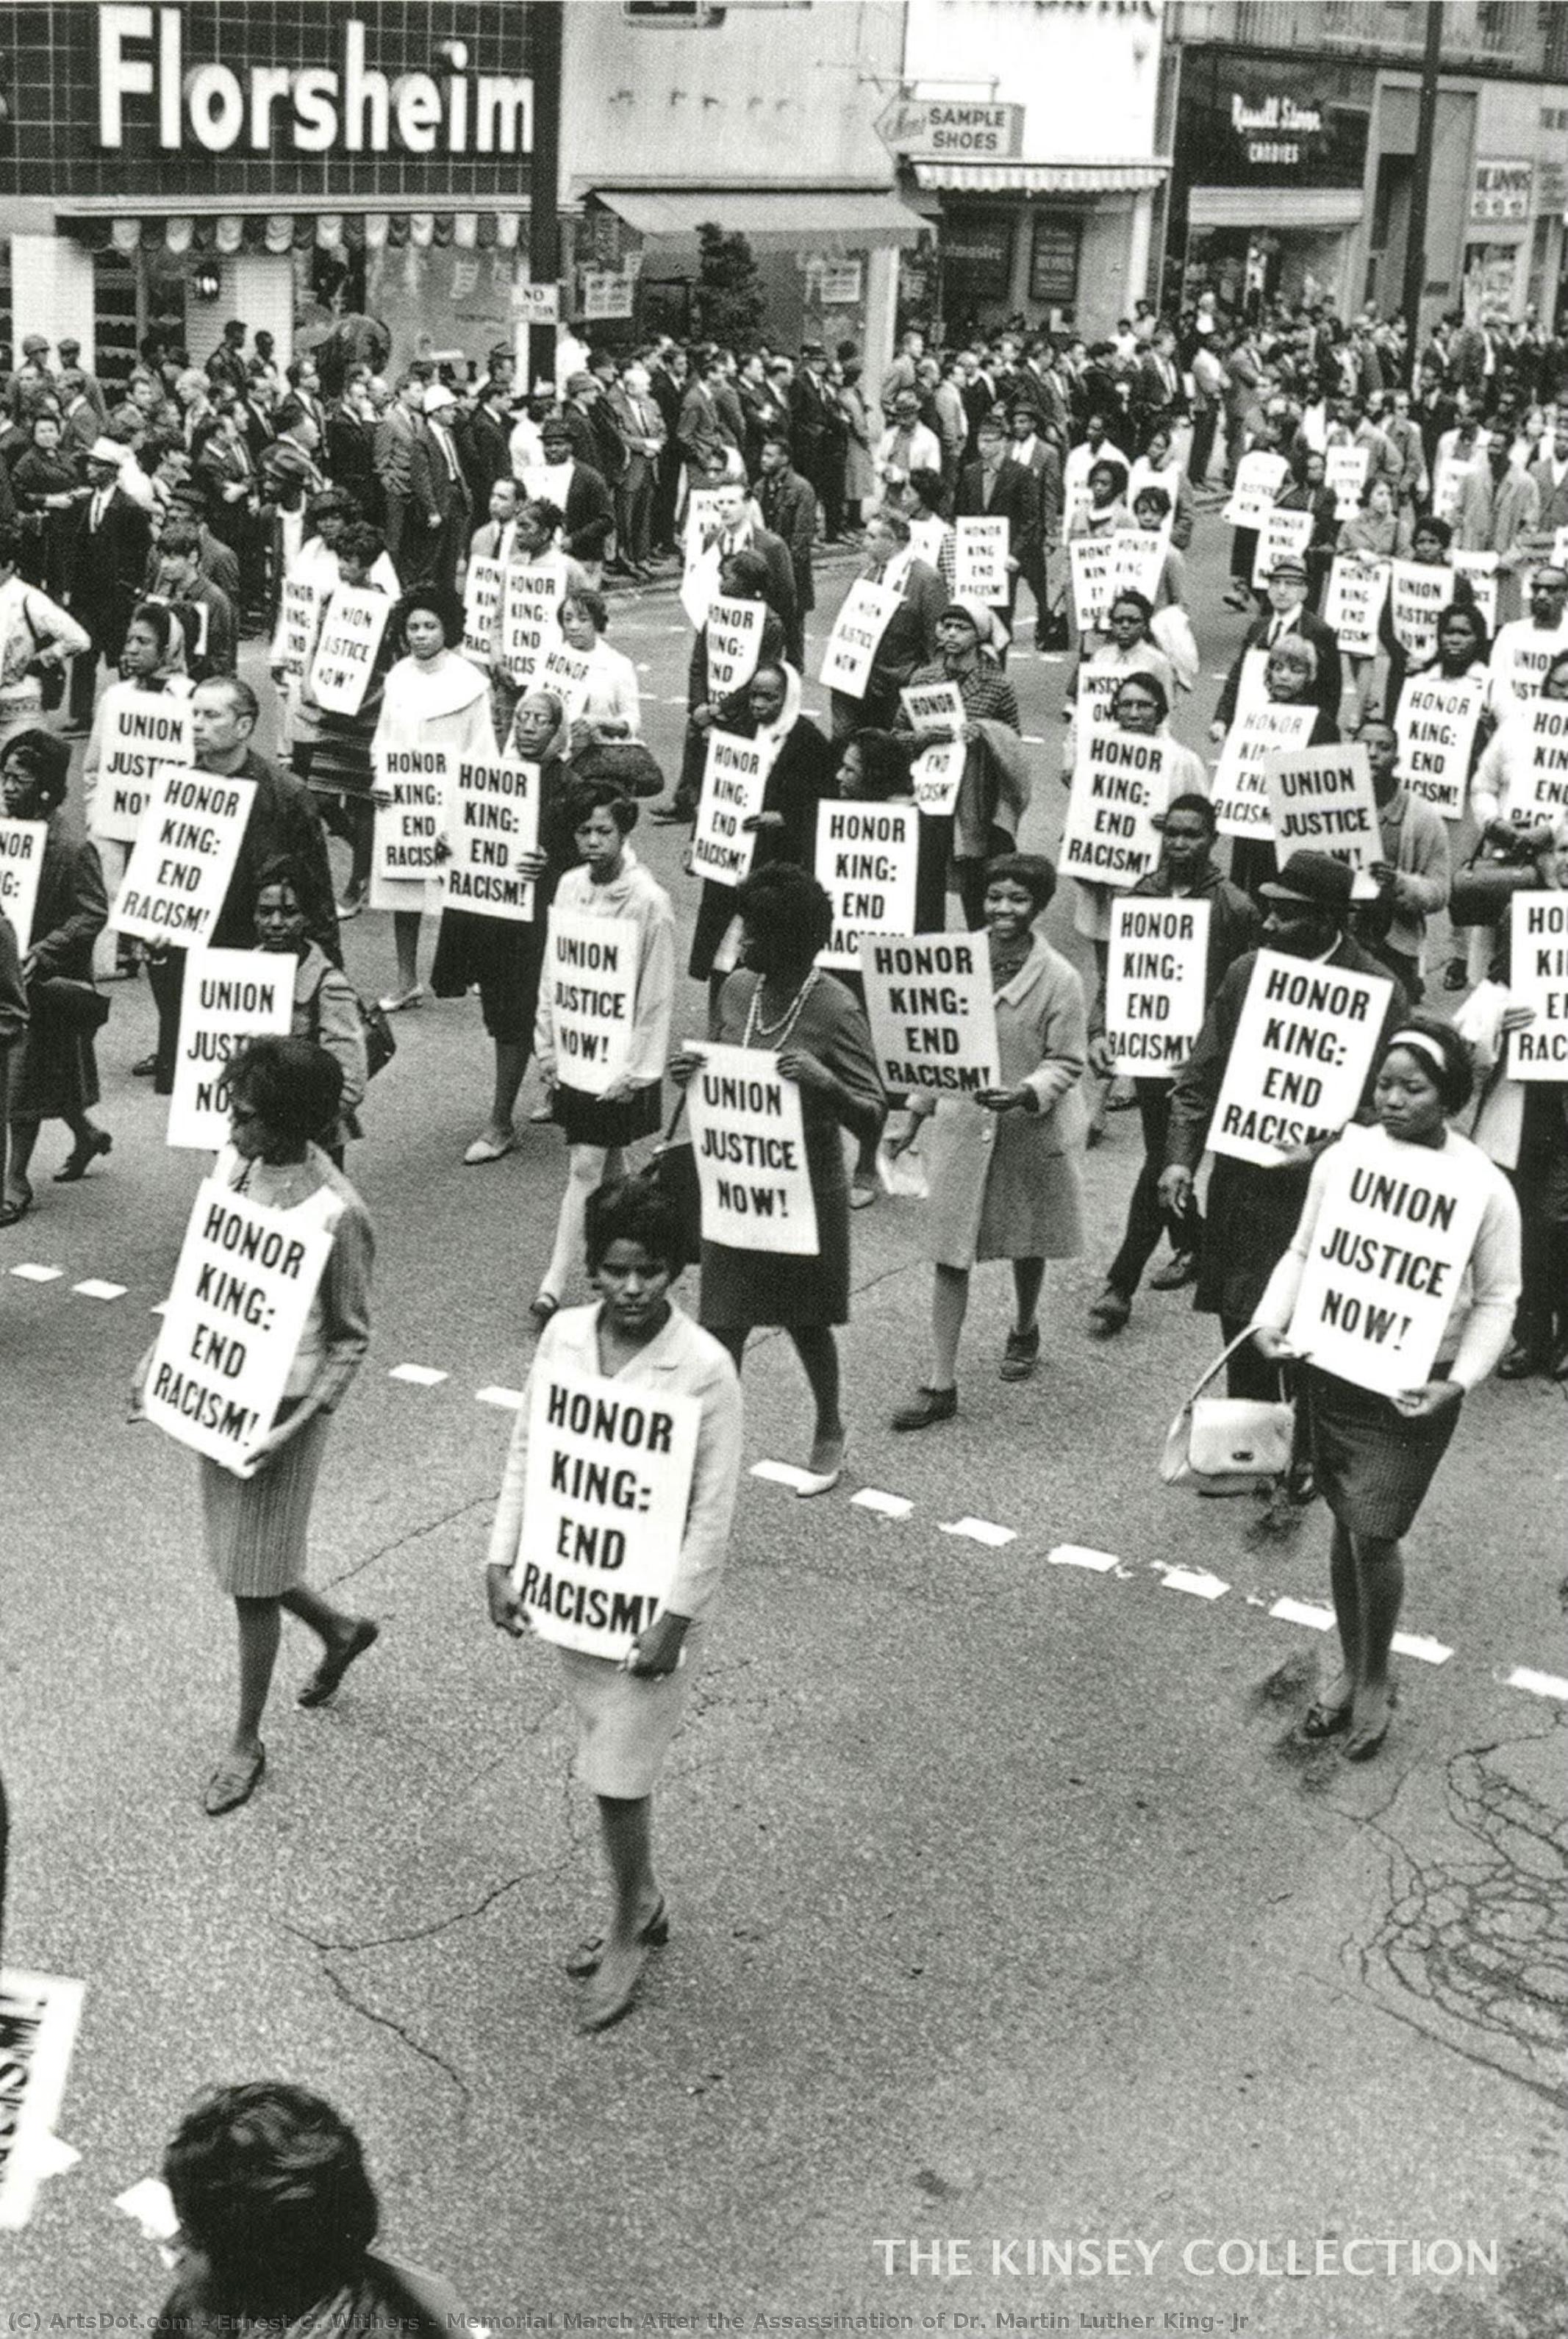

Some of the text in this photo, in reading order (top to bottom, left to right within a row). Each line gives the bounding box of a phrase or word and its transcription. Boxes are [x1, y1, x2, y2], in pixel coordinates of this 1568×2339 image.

[99, 5, 534, 152] Florsheim
[929, 107, 1006, 127] SAMPLE
[933, 130, 998, 150] SHOES
[475, 566, 501, 583] HON
[1398, 578, 1442, 598] UNION
[476, 591, 497, 606] KIN
[512, 629, 541, 649] END
[911, 692, 956, 717] HONOR
[1409, 690, 1470, 716] HONOR
[118, 712, 184, 743] UNION
[1244, 712, 1303, 734] HONOR
[1408, 720, 1457, 747] KING:
[387, 751, 446, 774] HONOR
[715, 744, 760, 776] HONOR
[926, 754, 951, 773] END
[1090, 737, 1163, 773] HONOR
[1411, 751, 1445, 774] END
[394, 784, 443, 806] KING:
[459, 763, 528, 798] HONOR
[712, 778, 748, 808] KING:
[1092, 773, 1150, 806] KING:
[1280, 767, 1356, 798] UNION
[114, 790, 150, 814] NO
[164, 779, 240, 817] HONOR
[402, 816, 436, 837] END
[465, 801, 519, 834] KING:
[711, 812, 736, 838] END
[830, 814, 906, 843] HONOR
[1094, 809, 1136, 838] END
[1281, 807, 1371, 838] JUSTICE
[160, 818, 221, 856] KING:
[470, 838, 509, 867] END
[695, 838, 746, 876] RACISM!
[836, 853, 898, 882] KING:
[1068, 838, 1152, 875] RACISM!
[157, 859, 202, 892] END
[449, 870, 526, 906] RACISM!
[121, 891, 211, 934] RACISM!
[842, 892, 885, 920] END
[1120, 911, 1195, 940] HONOR
[556, 936, 619, 972] UNION
[874, 945, 974, 975] HONOR
[1123, 953, 1184, 982] KING:
[200, 980, 276, 1014] UNION
[888, 987, 969, 1016] KING:
[1126, 992, 1170, 1021] END
[1264, 968, 1371, 1022] HONOR
[905, 1026, 959, 1055] END
[1263, 1017, 1347, 1067] KING:
[884, 1060, 990, 1092] RACISM!
[1261, 1067, 1323, 1108] END
[196, 1083, 229, 1111] NO
[703, 1074, 781, 1116] UNION
[701, 1128, 798, 1171] JUSTICE
[717, 1179, 789, 1218] NOW!
[1350, 1167, 1458, 1232] UNION
[203, 1203, 306, 1280] HONOR
[1320, 1227, 1451, 1297] JUSTICE
[196, 1262, 276, 1330] KING:
[1320, 1289, 1412, 1351] NOW!
[190, 1323, 247, 1378] END
[153, 1362, 260, 1447] RACISM!
[548, 1383, 674, 1454] HONOR
[551, 1450, 651, 1513] KING:
[556, 1516, 626, 1571] END
[519, 1561, 659, 1636] RACISM!
